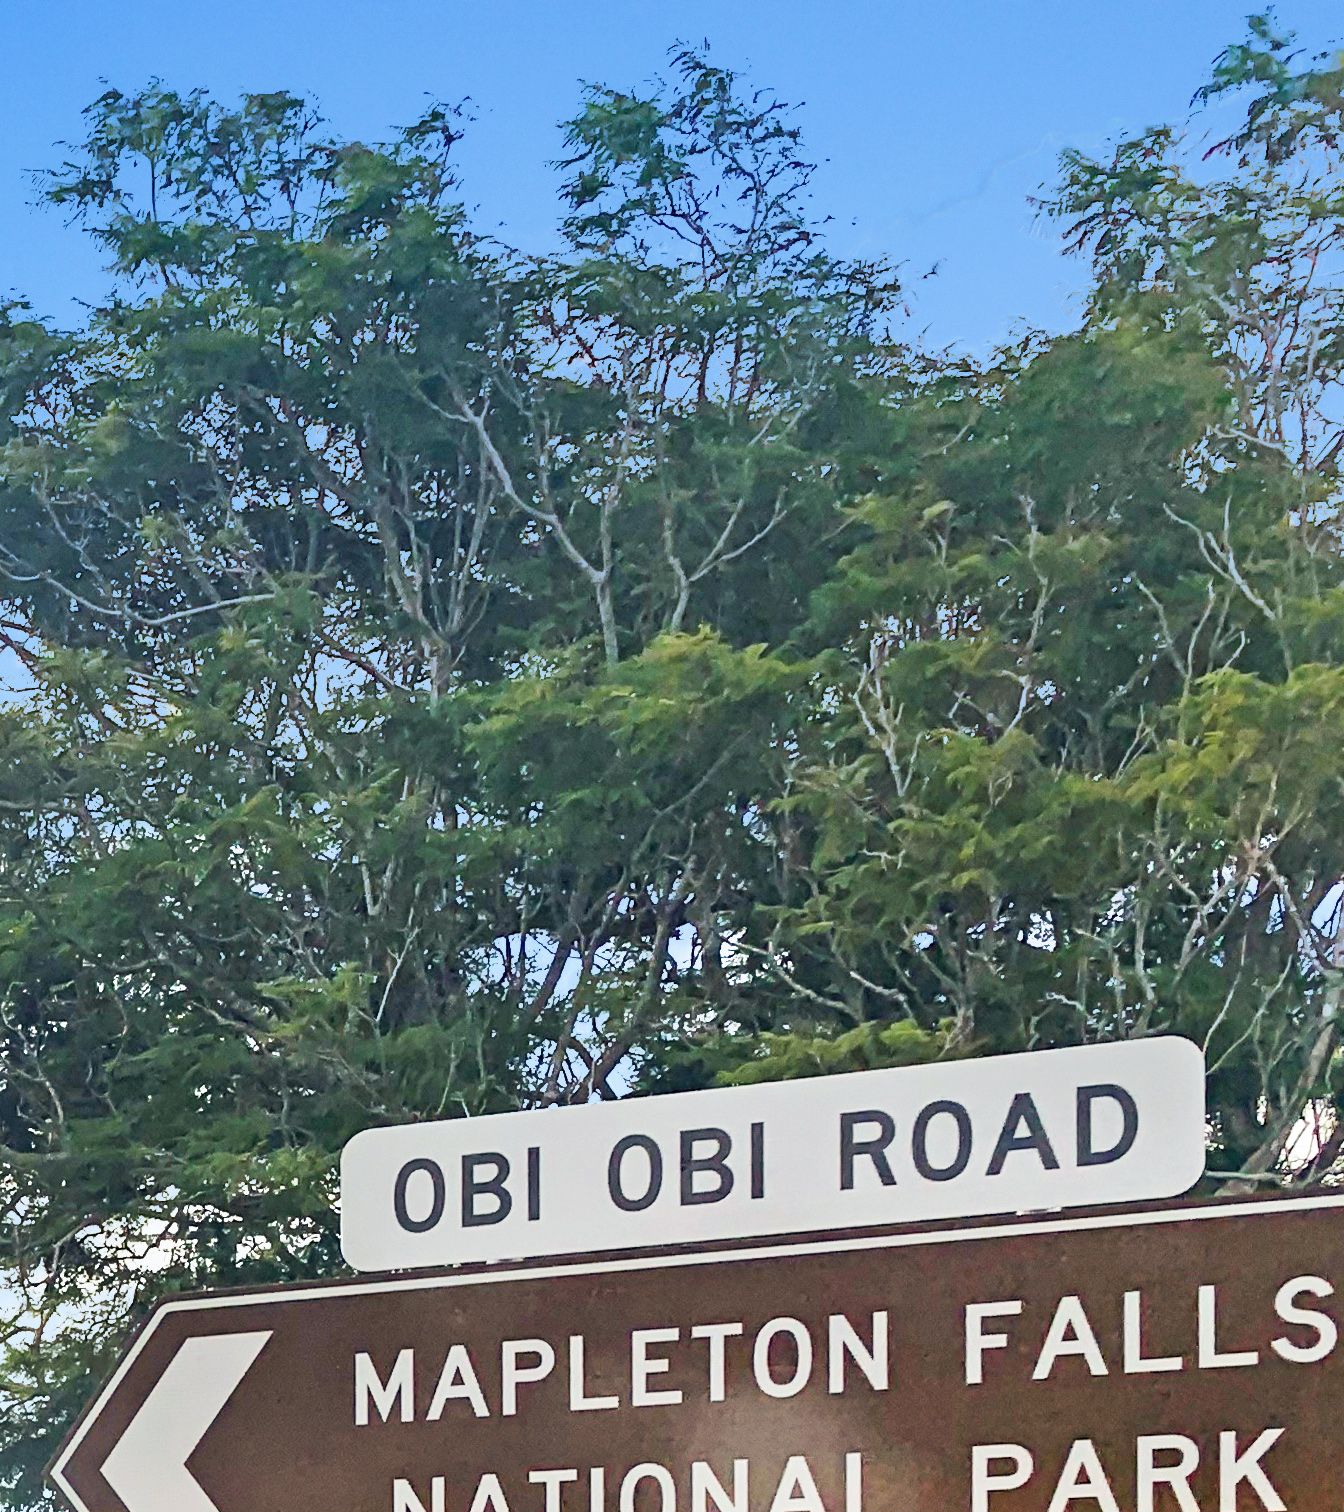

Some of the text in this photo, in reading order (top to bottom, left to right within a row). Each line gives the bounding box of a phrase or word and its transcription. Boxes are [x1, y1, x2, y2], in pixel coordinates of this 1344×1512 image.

[393, 1083, 1140, 1233] OBI OBI ROAD
[354, 1274, 1338, 1426] MAPLETON FALLS
